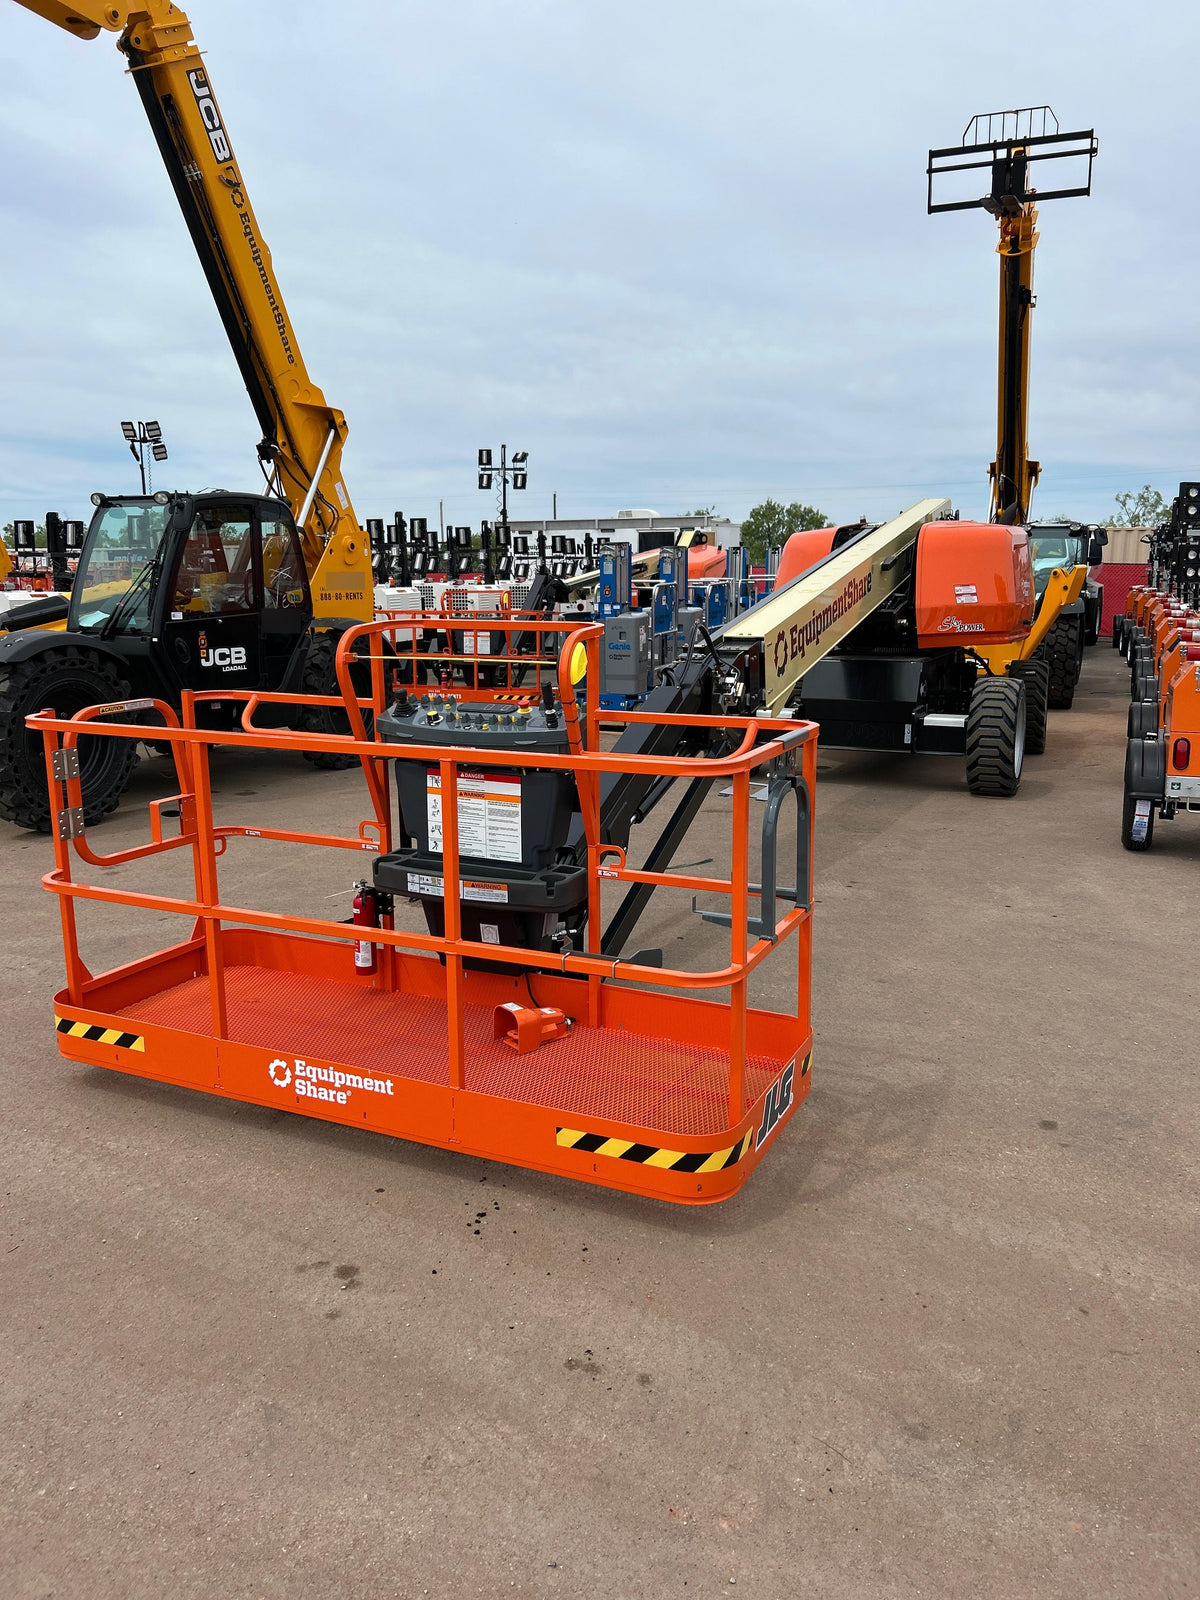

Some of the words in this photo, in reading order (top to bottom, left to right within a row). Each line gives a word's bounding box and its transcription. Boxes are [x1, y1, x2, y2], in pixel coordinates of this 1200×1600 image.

[189, 70, 231, 162] JCB
[320, 592, 363, 600] 888-80-RENTS
[789, 572, 872, 660] EquipmentShare
[200, 647, 247, 667] JCB
[608, 642, 631, 650] Genie
[475, 882, 501, 890] WARNING
[294, 1059, 394, 1096] Equipment
[755, 1058, 796, 1152] JLG
